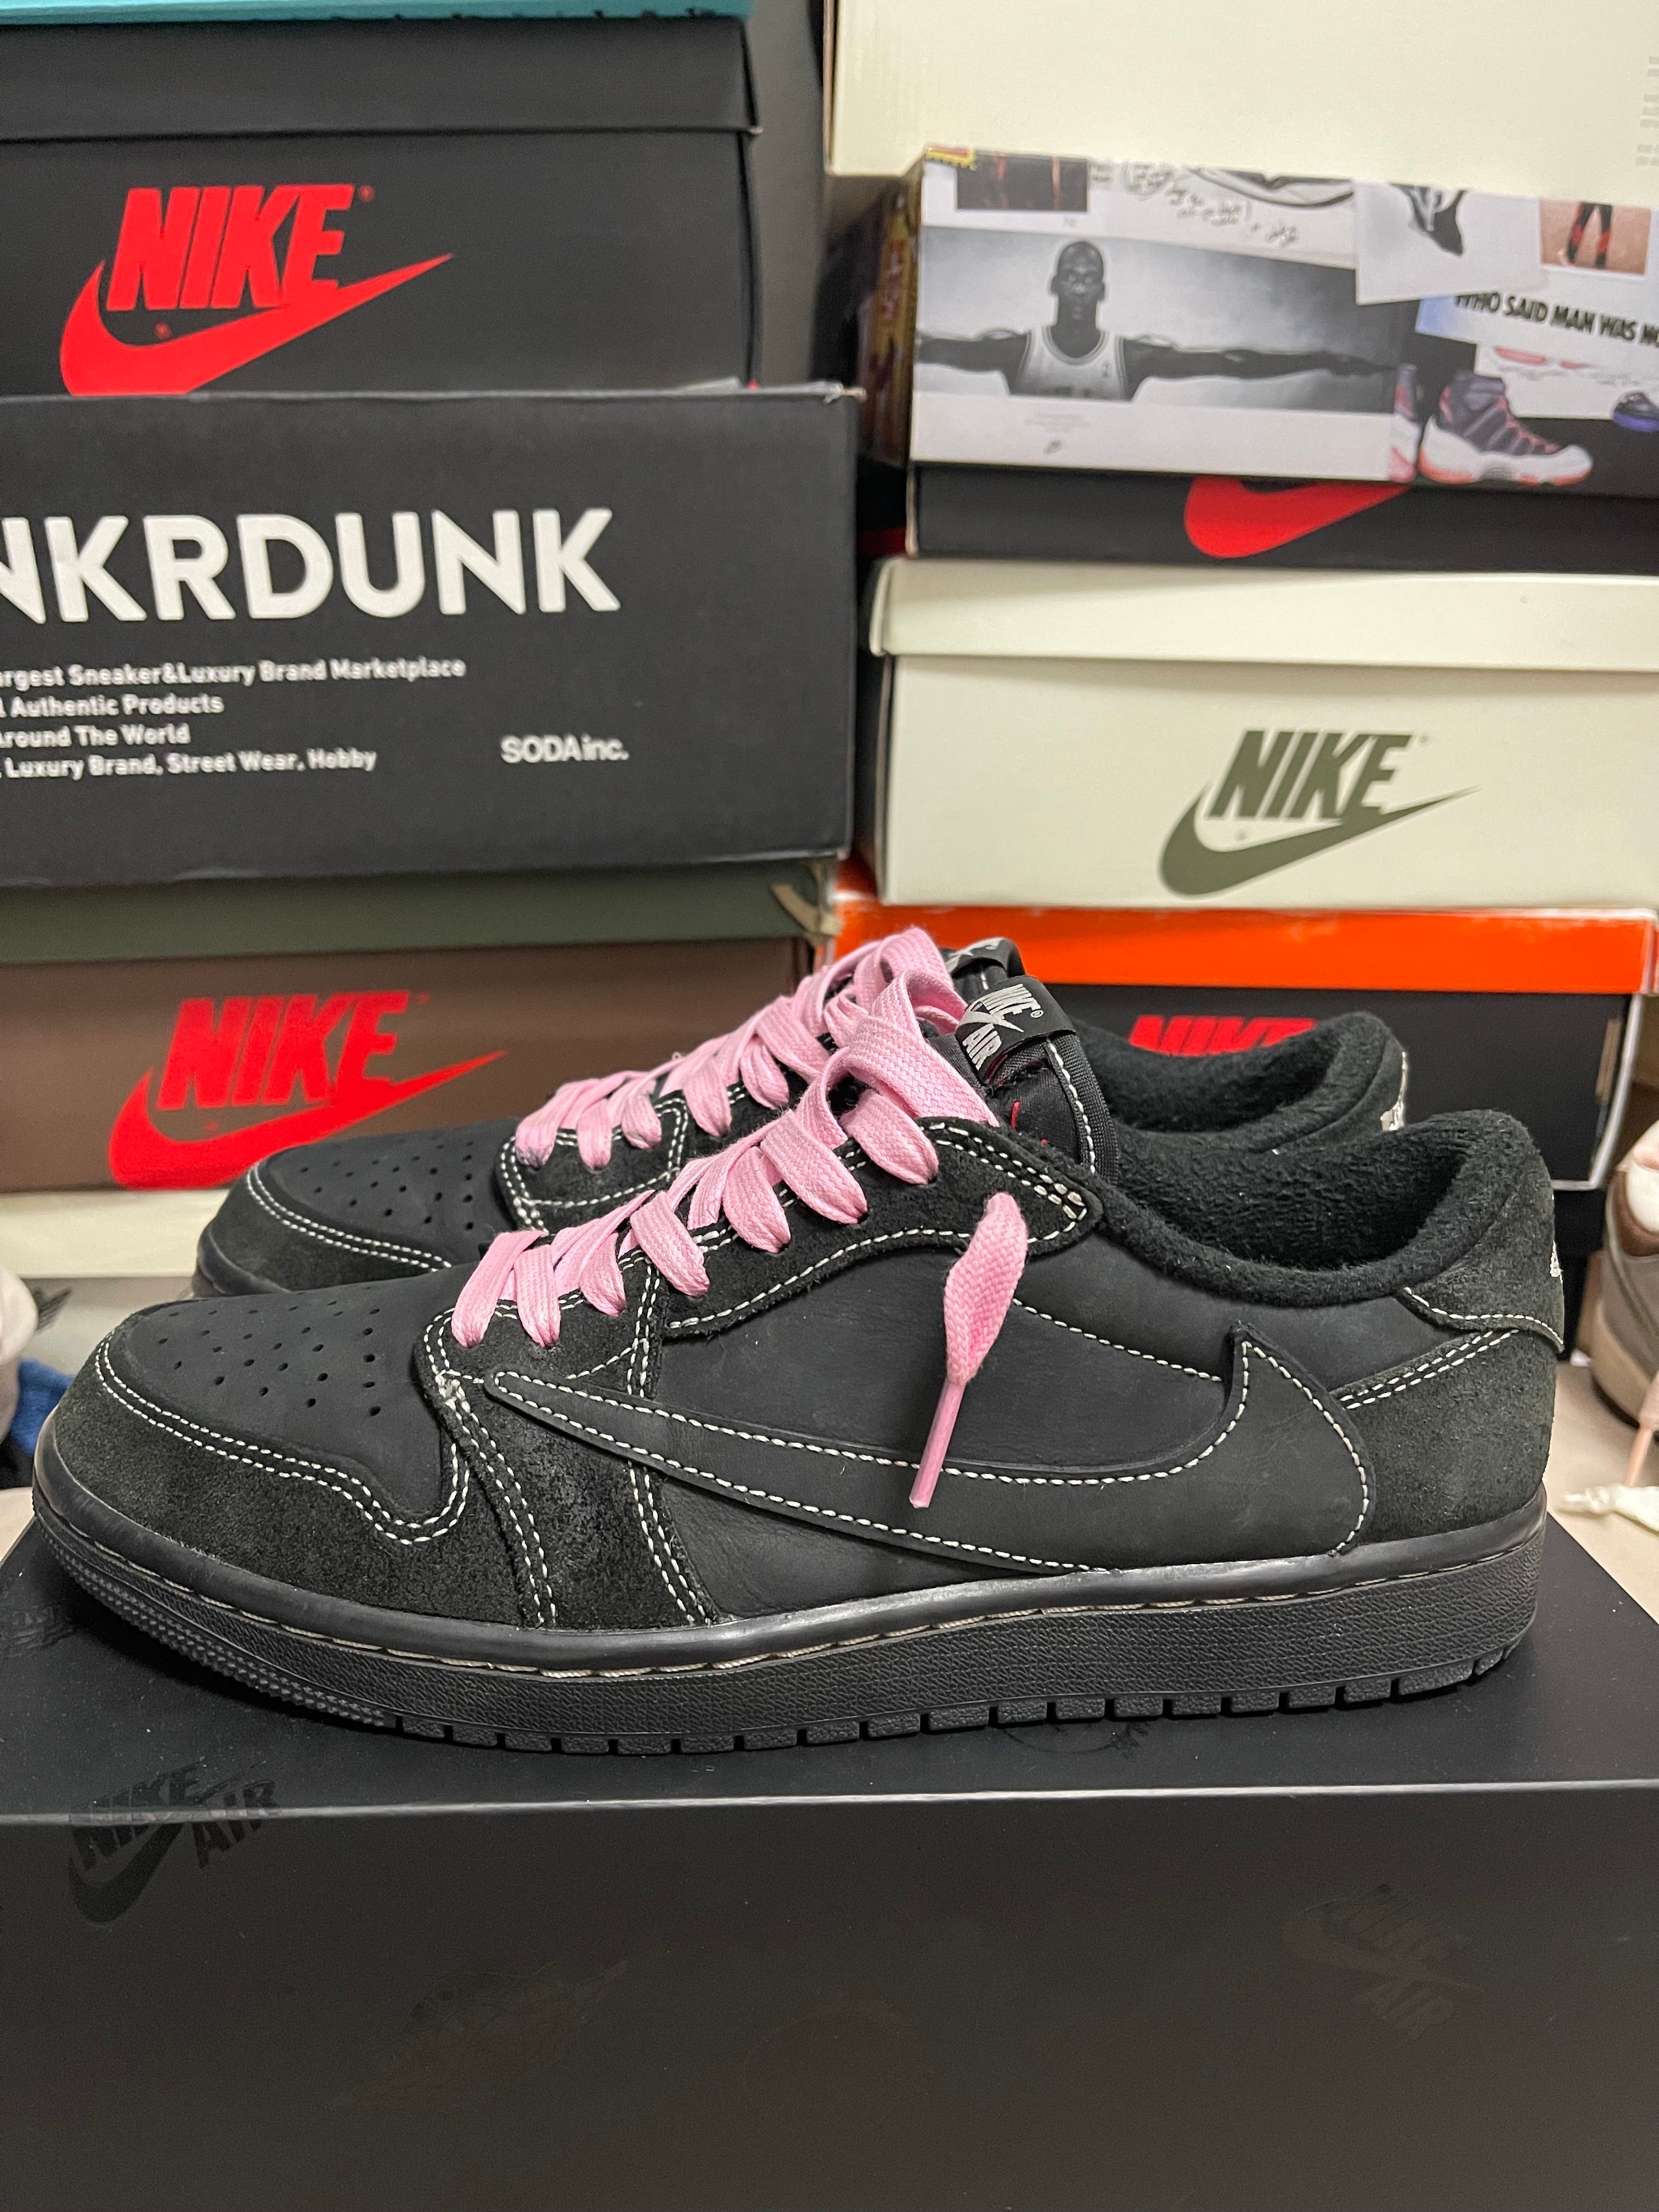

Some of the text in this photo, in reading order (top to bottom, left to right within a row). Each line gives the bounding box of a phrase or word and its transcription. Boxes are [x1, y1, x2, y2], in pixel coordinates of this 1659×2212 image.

[106, 184, 355, 311] NIKE
[1502, 295, 1548, 323] SAID
[1552, 305, 1596, 334] MAN
[1599, 312, 1637, 341] WAS
[67, 662, 256, 687] Sneaker&Luxury
[258, 659, 328, 681] Brand
[330, 656, 466, 681] Marketplace
[10, 695, 120, 718] Authentic
[121, 692, 225, 715] Products
[73, 725, 119, 747] The
[120, 723, 191, 746] World
[4, 757, 84, 781] Luxury
[166, 752, 237, 774] Street
[306, 747, 377, 772] Hobby
[1204, 730, 1413, 820] NIKE
[970, 983, 1041, 1019] NIKE
[156, 990, 410, 1111] NIKE
[962, 1023, 1002, 1070] AIR
